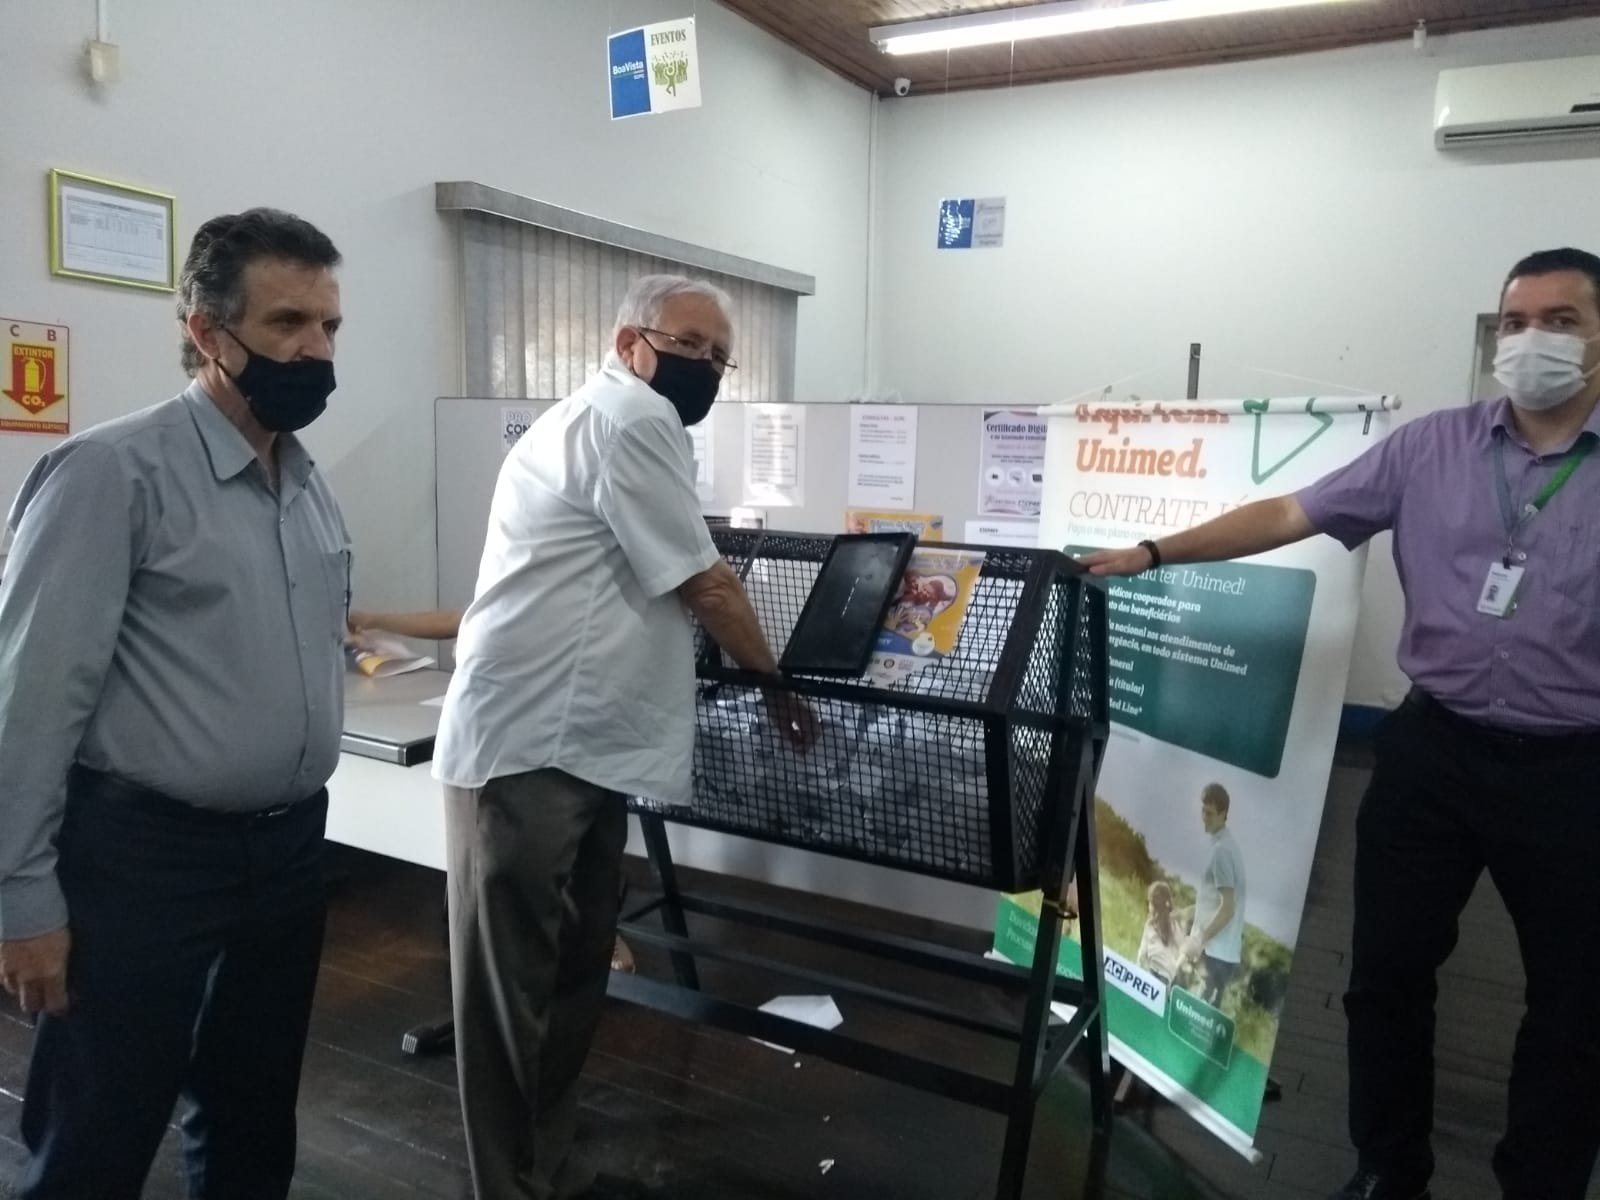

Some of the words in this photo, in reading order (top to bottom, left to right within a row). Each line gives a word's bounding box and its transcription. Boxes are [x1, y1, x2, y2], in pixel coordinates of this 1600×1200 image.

[650, 29, 687, 46] EVENTOS
[612, 61, 644, 75] BoaVista
[10, 324, 20, 337] C
[47, 329, 57, 341] B
[14, 346, 54, 359] EXTINTOR
[986, 423, 1026, 433] Certificado
[1076, 436, 1208, 479] Unimed.
[1069, 490, 1208, 529] CONTRATE
[1160, 568, 1178, 584] ter
[1182, 570, 1246, 595] Unimed!
[1118, 601, 1131, 613] dos
[1131, 603, 1181, 623] beneficiários
[1133, 592, 1177, 608] cooperados
[1178, 600, 1201, 612] para
[1115, 623, 1147, 638] nacional
[1160, 633, 1222, 654] atendimentos
[1223, 644, 1236, 657] de
[1109, 655, 1135, 672] uneral
[1141, 643, 1153, 654] em
[1153, 645, 1171, 658] todo
[1171, 649, 1209, 666] sistema
[1210, 657, 1248, 676] Unimed
[1115, 677, 1145, 697] (titular)
[1175, 999, 1214, 1029] Unimed
